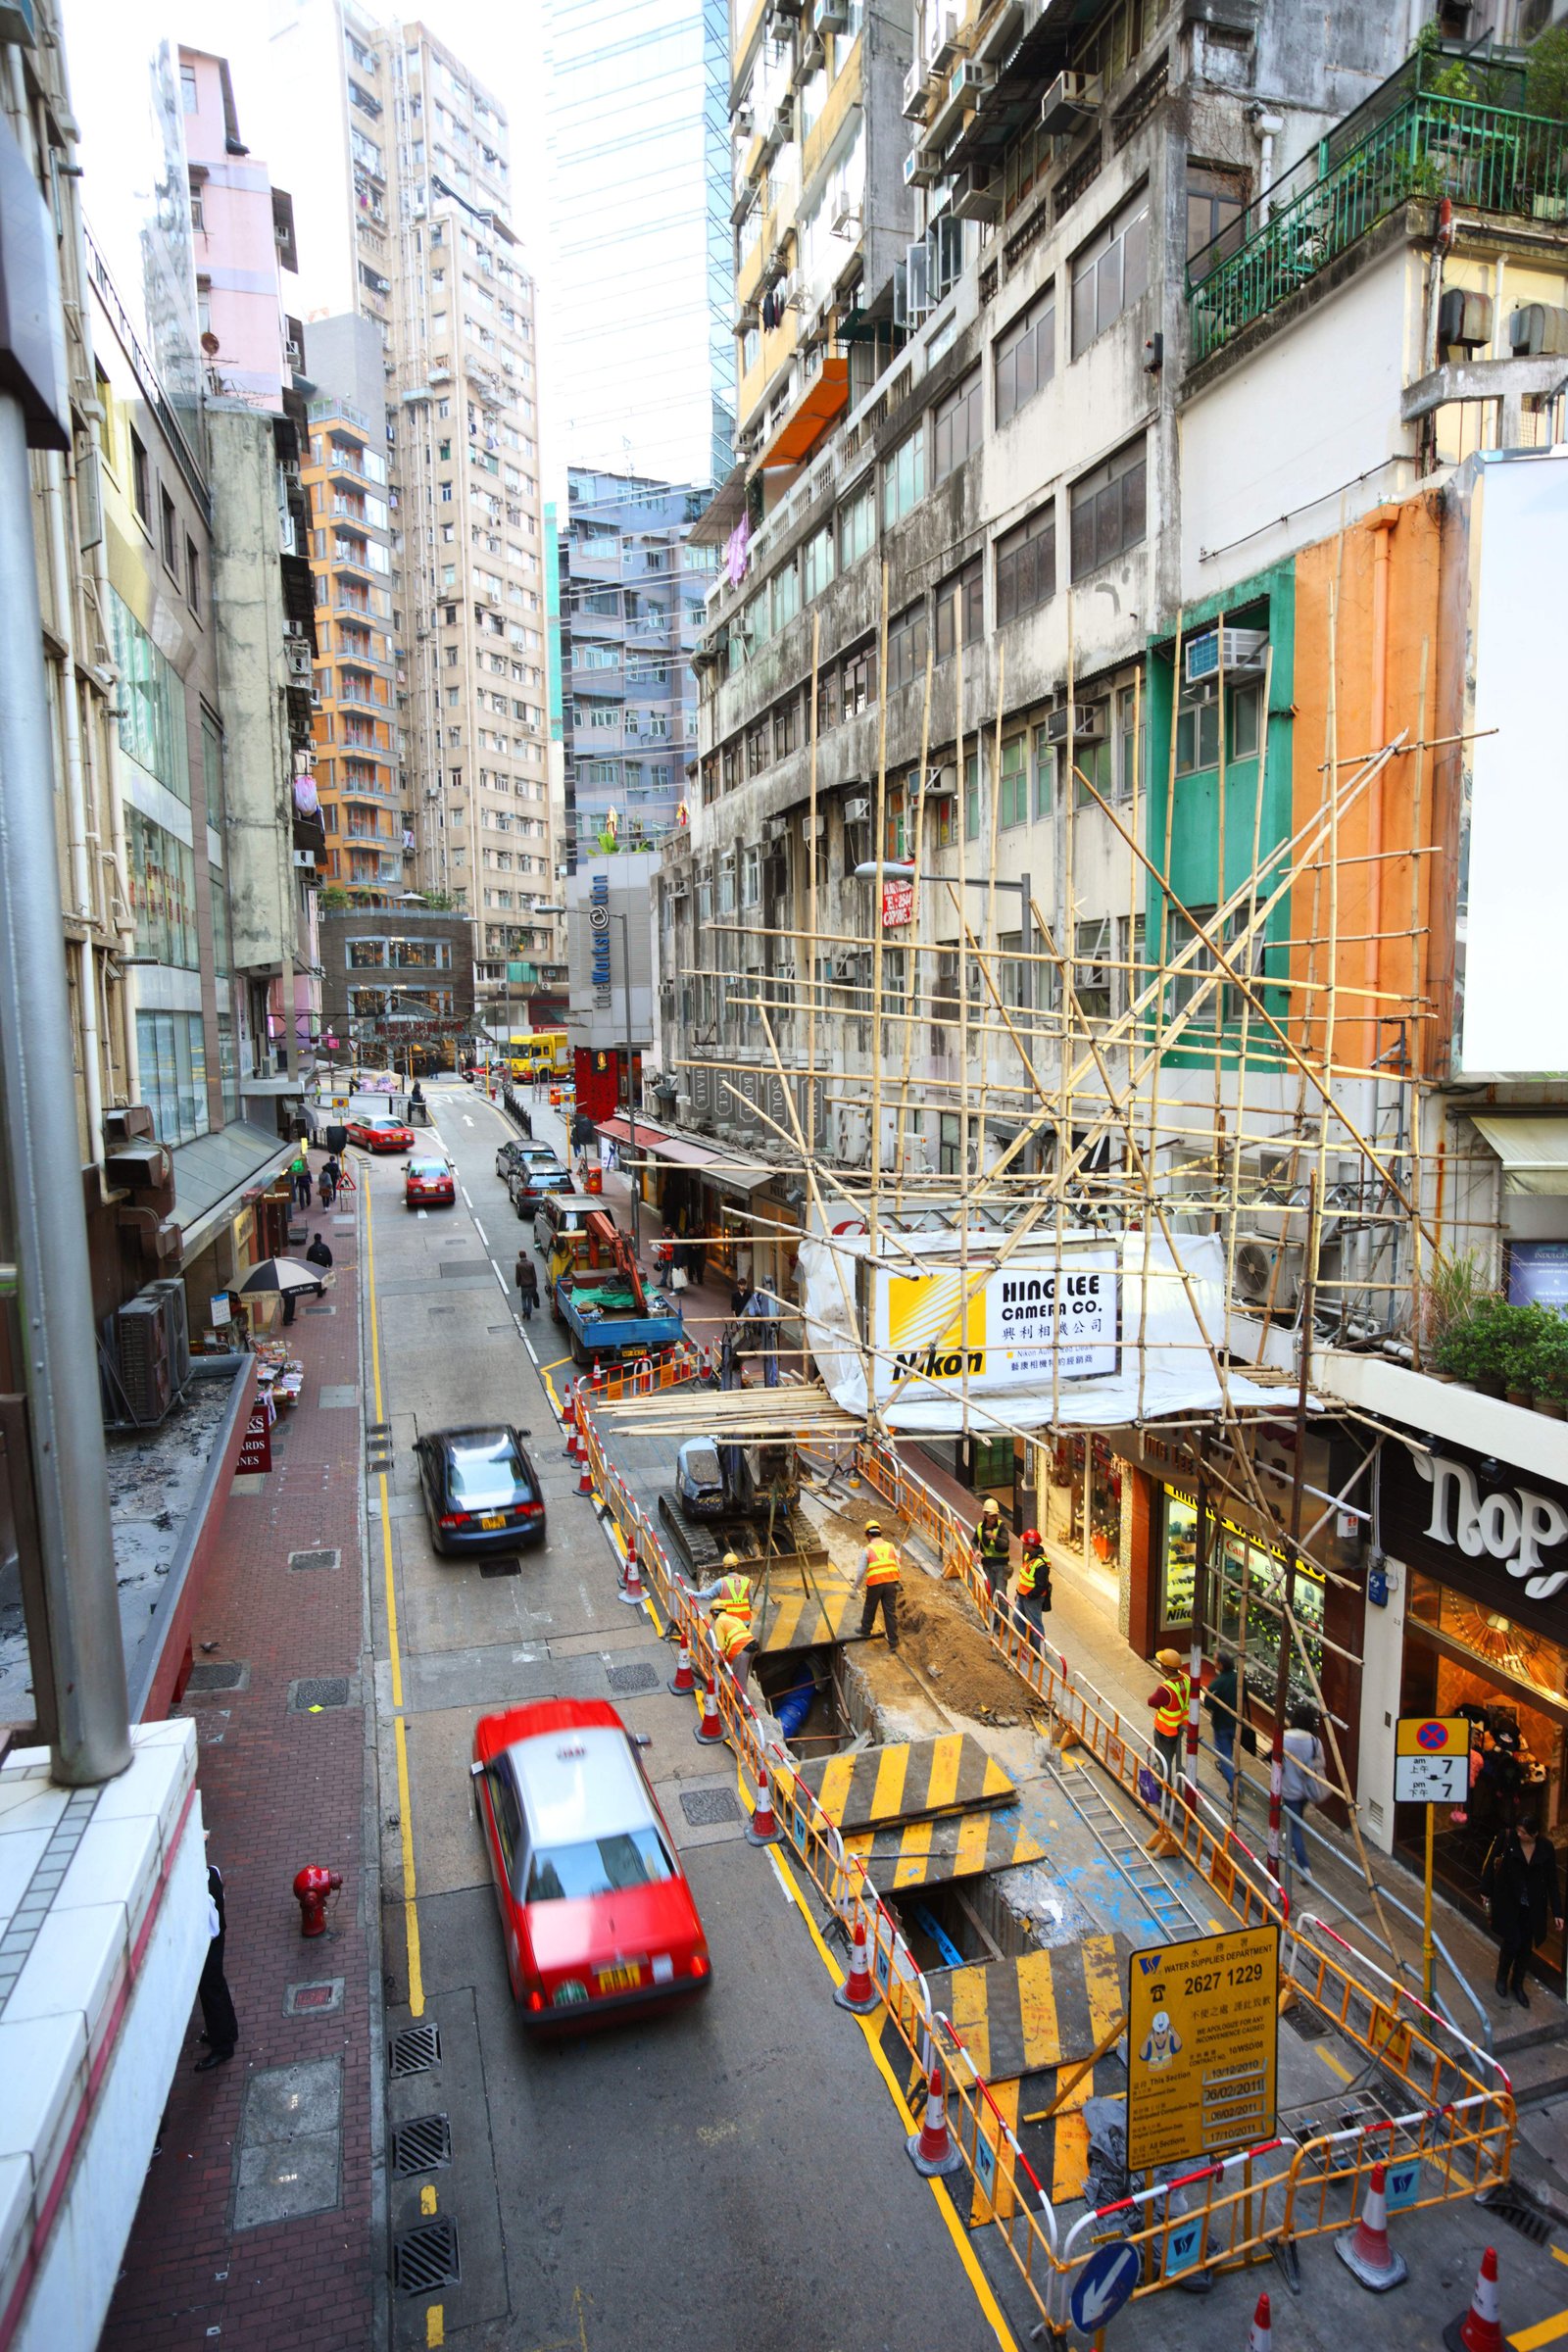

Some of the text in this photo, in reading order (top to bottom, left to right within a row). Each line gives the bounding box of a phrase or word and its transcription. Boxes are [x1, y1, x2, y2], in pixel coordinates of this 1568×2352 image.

[697, 1070, 706, 1102] HAIR
[772, 1083, 782, 1119] SOUL
[1003, 1275, 1099, 1302] HING LEE
[1002, 1300, 1102, 1320] CAMERA CO.
[893, 1351, 983, 1381] Nikon
[1226, 1540, 1254, 1565] Cann
[1410, 1765, 1429, 1774] 上午
[1442, 1759, 1453, 1774] 7
[1410, 1788, 1428, 1797] 下午
[1442, 1783, 1452, 1797] 7
[1164, 1944, 1273, 1974] WATER SUPPLIES DEPARTMENT
[1185, 1963, 1262, 1995] 2627 1229
[1196, 2024, 1265, 2044] INCONVENIENCE CAUSED
[1189, 2056, 1216, 2067] CONTRACT
[1165, 2071, 1191, 2082] Section
[1160, 2136, 1186, 2147] Sections
